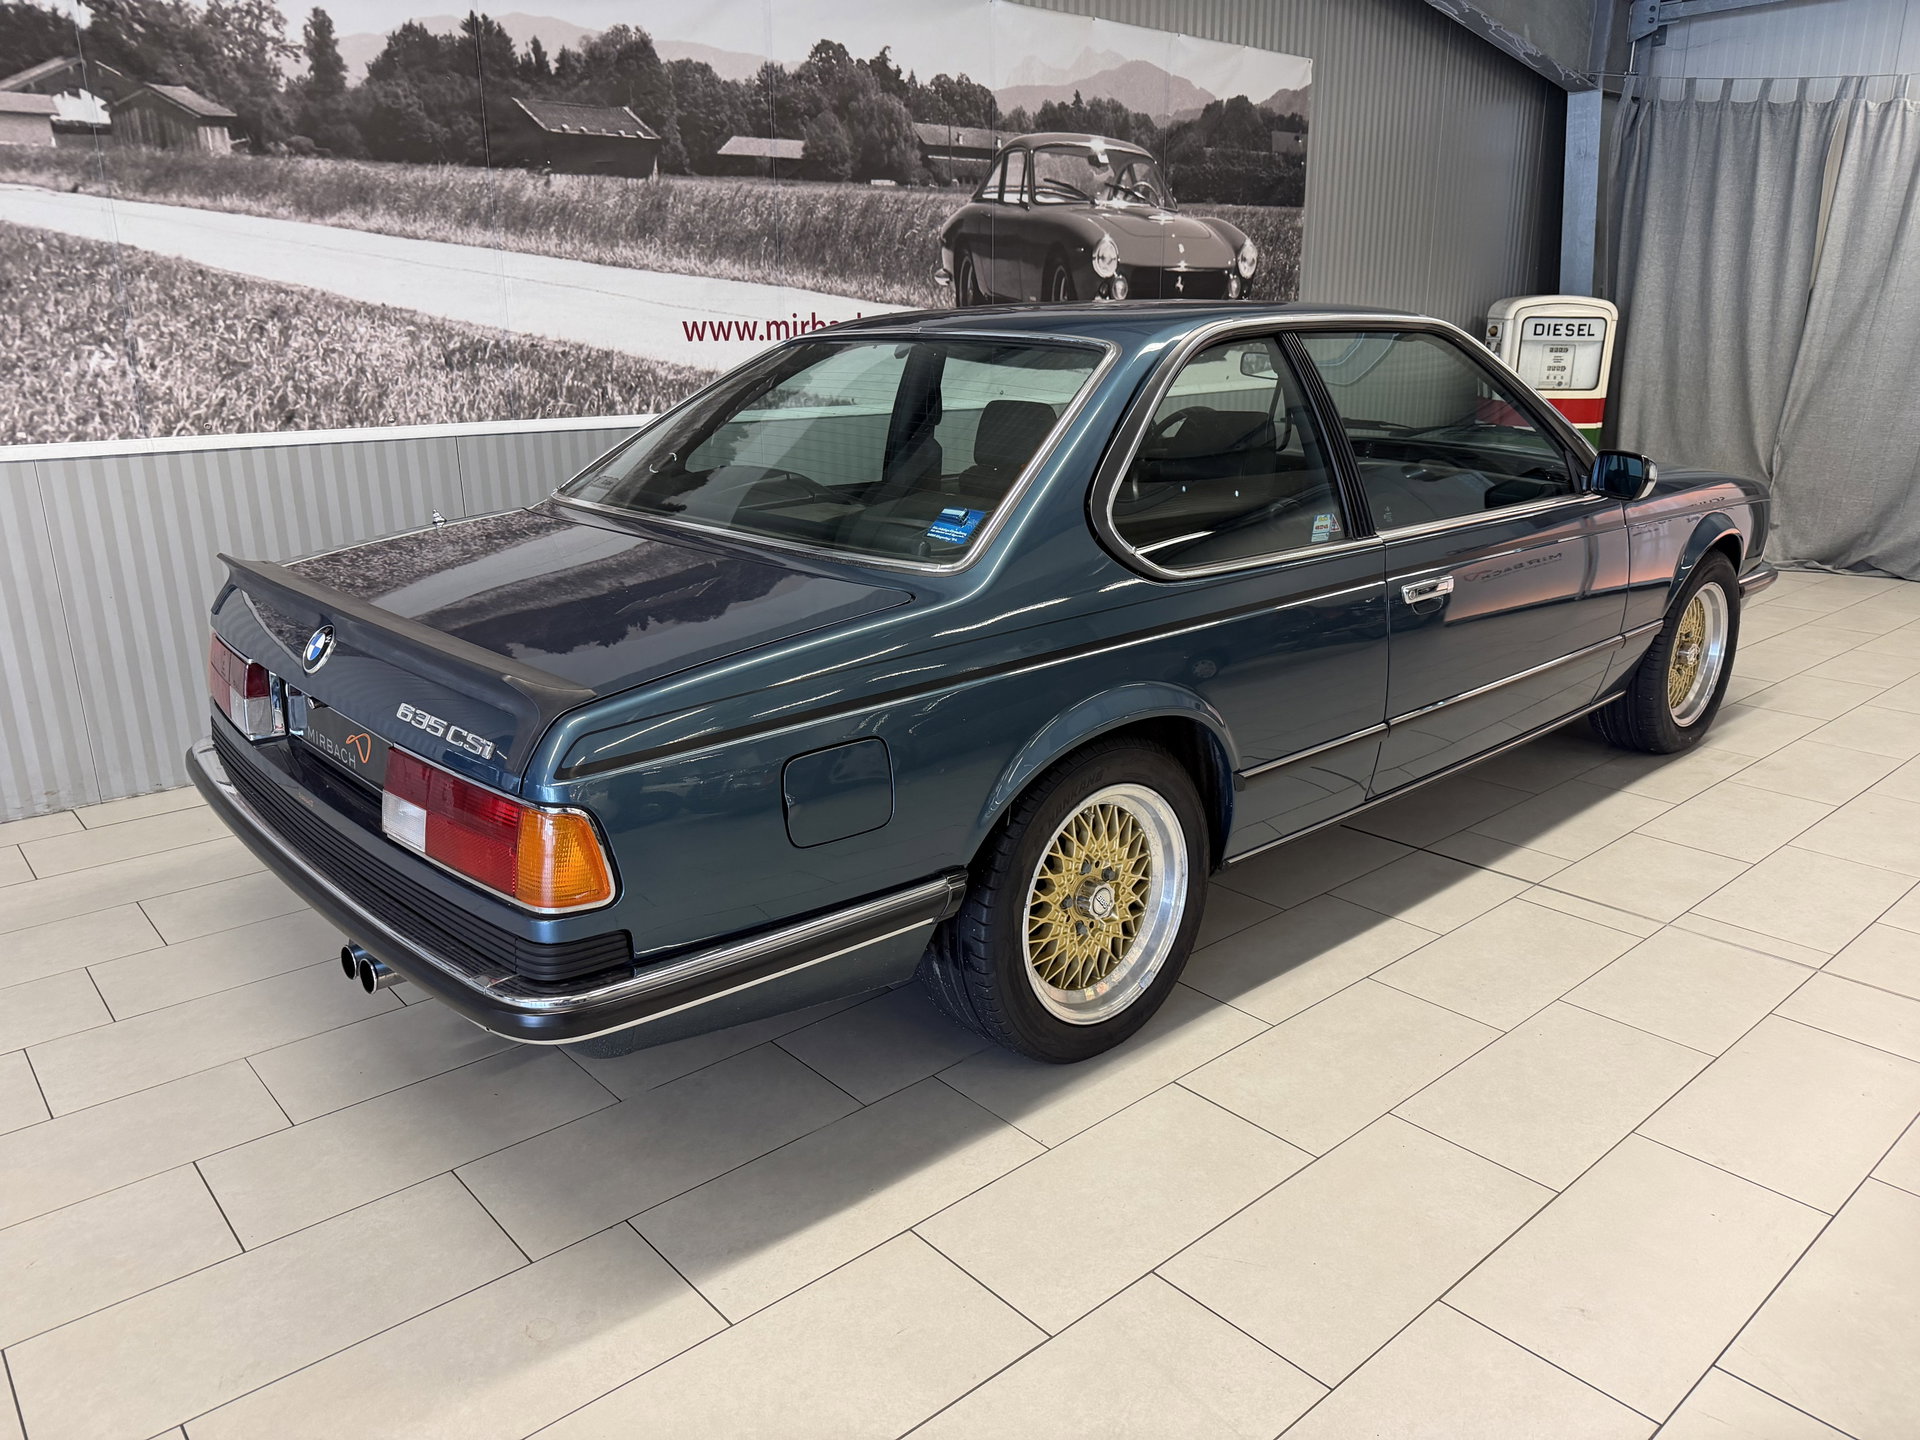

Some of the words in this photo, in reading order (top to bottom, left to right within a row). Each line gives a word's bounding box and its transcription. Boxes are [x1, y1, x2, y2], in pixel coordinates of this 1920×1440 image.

[1533, 323, 1595, 337] DIESEL
[307, 725, 356, 769] MIRBACH
[396, 702, 448, 737] 635
[445, 725, 494, 760] CSi
